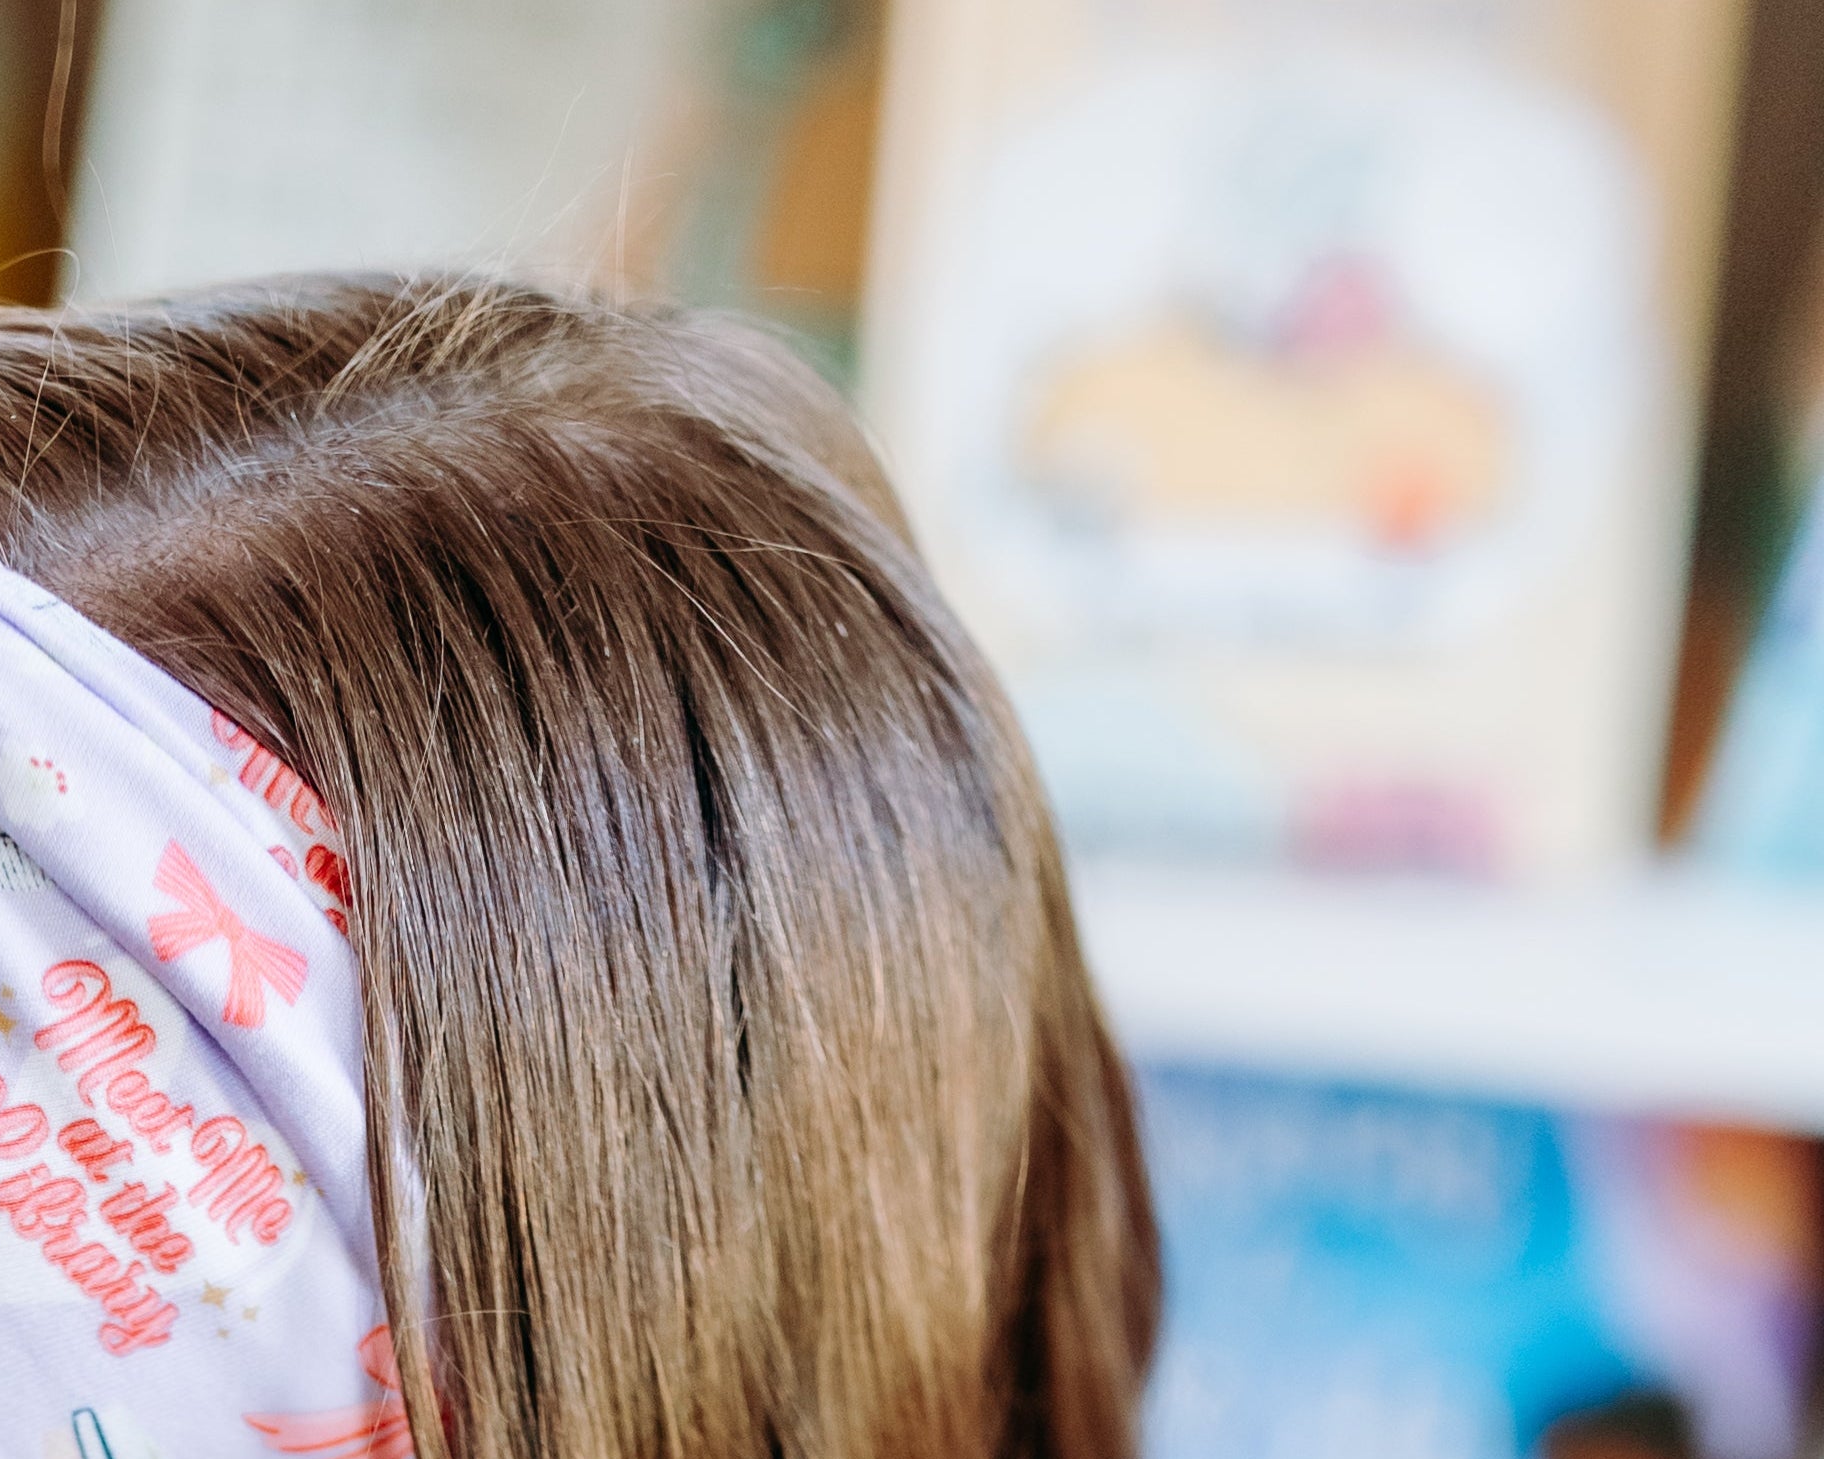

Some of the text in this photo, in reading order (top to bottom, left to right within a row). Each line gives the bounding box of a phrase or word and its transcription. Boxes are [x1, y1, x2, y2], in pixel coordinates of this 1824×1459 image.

[34, 959, 294, 1245] Meet Me
[57, 1117, 194, 1274] at the
